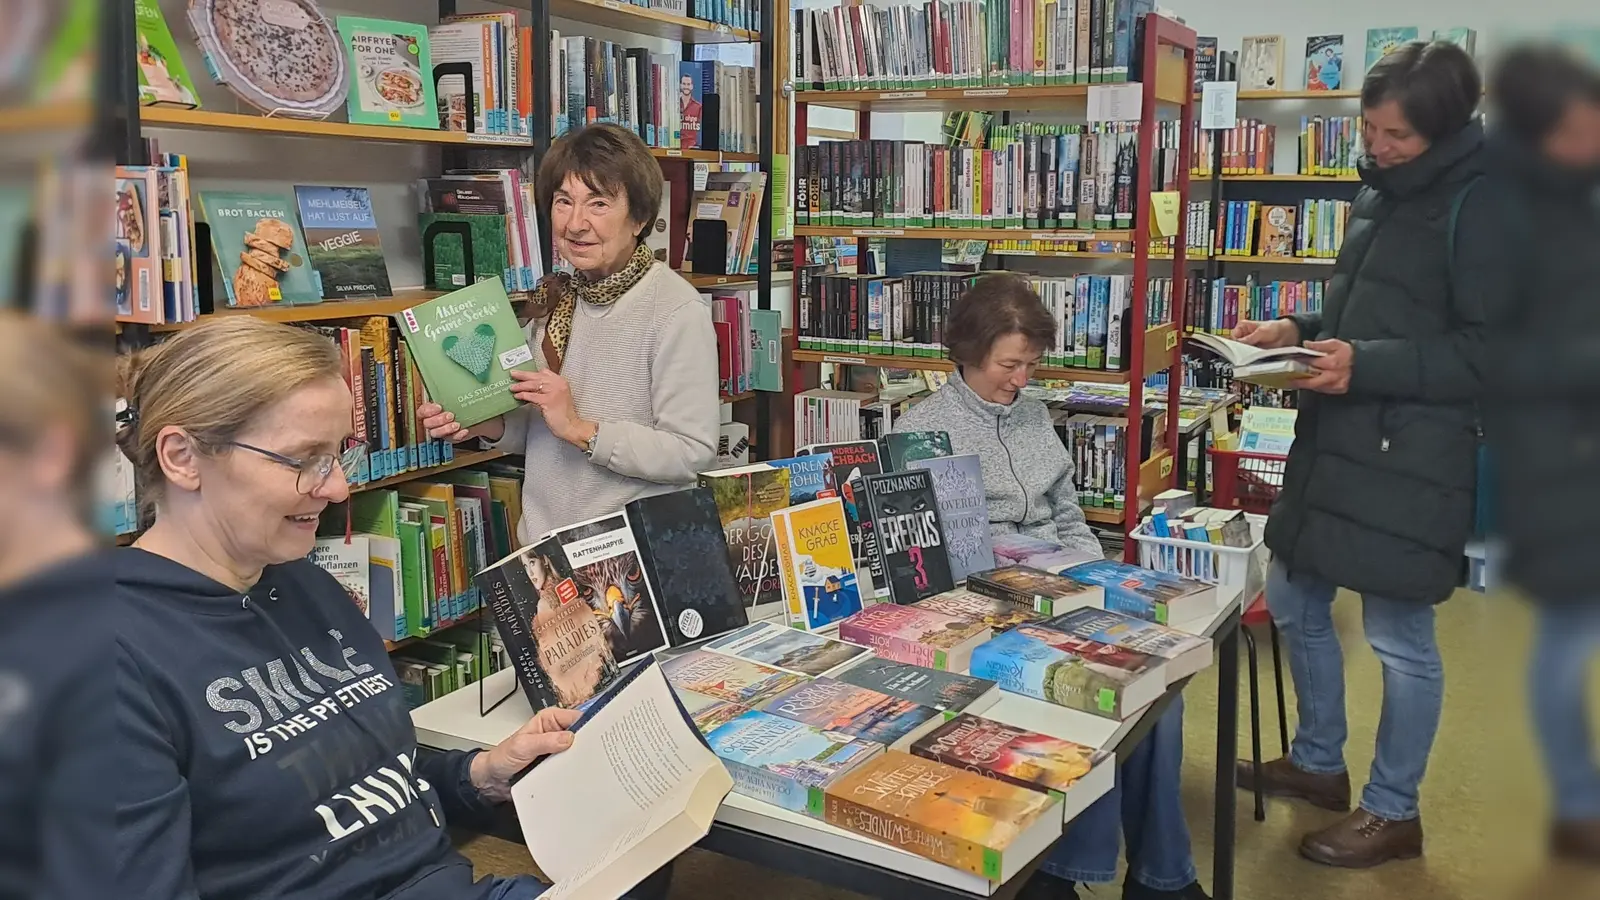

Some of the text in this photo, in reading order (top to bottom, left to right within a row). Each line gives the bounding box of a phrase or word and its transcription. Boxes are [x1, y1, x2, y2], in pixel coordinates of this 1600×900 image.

[351, 35, 397, 46] AIRFRYER
[352, 45, 396, 55] FOR ONE
[798, 178, 807, 208] FÖHR
[810, 178, 818, 208] FÖHR
[218, 209, 285, 218] BROT BACKEN
[308, 212, 371, 222] HAT LUST AUF
[319, 231, 362, 252] VEGGIE
[405, 311, 418, 331] TOPP
[356, 375, 367, 438] REISEHUNGER
[457, 392, 475, 403] DAS
[872, 474, 927, 496] POZNANSKI
[806, 533, 838, 551] GRAB
[878, 510, 941, 555] EREBOS
[572, 538, 625, 560] RATTENHARPYIE
[743, 543, 764, 562] DES
[865, 531, 883, 578] EREBOS
[907, 545, 930, 592] 3
[492, 581, 521, 637] PARADIES
[493, 600, 506, 623] CLUB
[681, 611, 692, 631] FITZEK
[555, 618, 576, 639] CLUB
[544, 620, 598, 666] PARADIES
[205, 628, 375, 734] SMILE
[519, 655, 534, 685] CAREN
[521, 647, 544, 689] BENEDIKT
[683, 657, 734, 685] AVENUE
[243, 731, 273, 760] IS
[273, 708, 318, 742] THE
[723, 727, 759, 755] OCEAN
[741, 723, 796, 756] AVENUE
